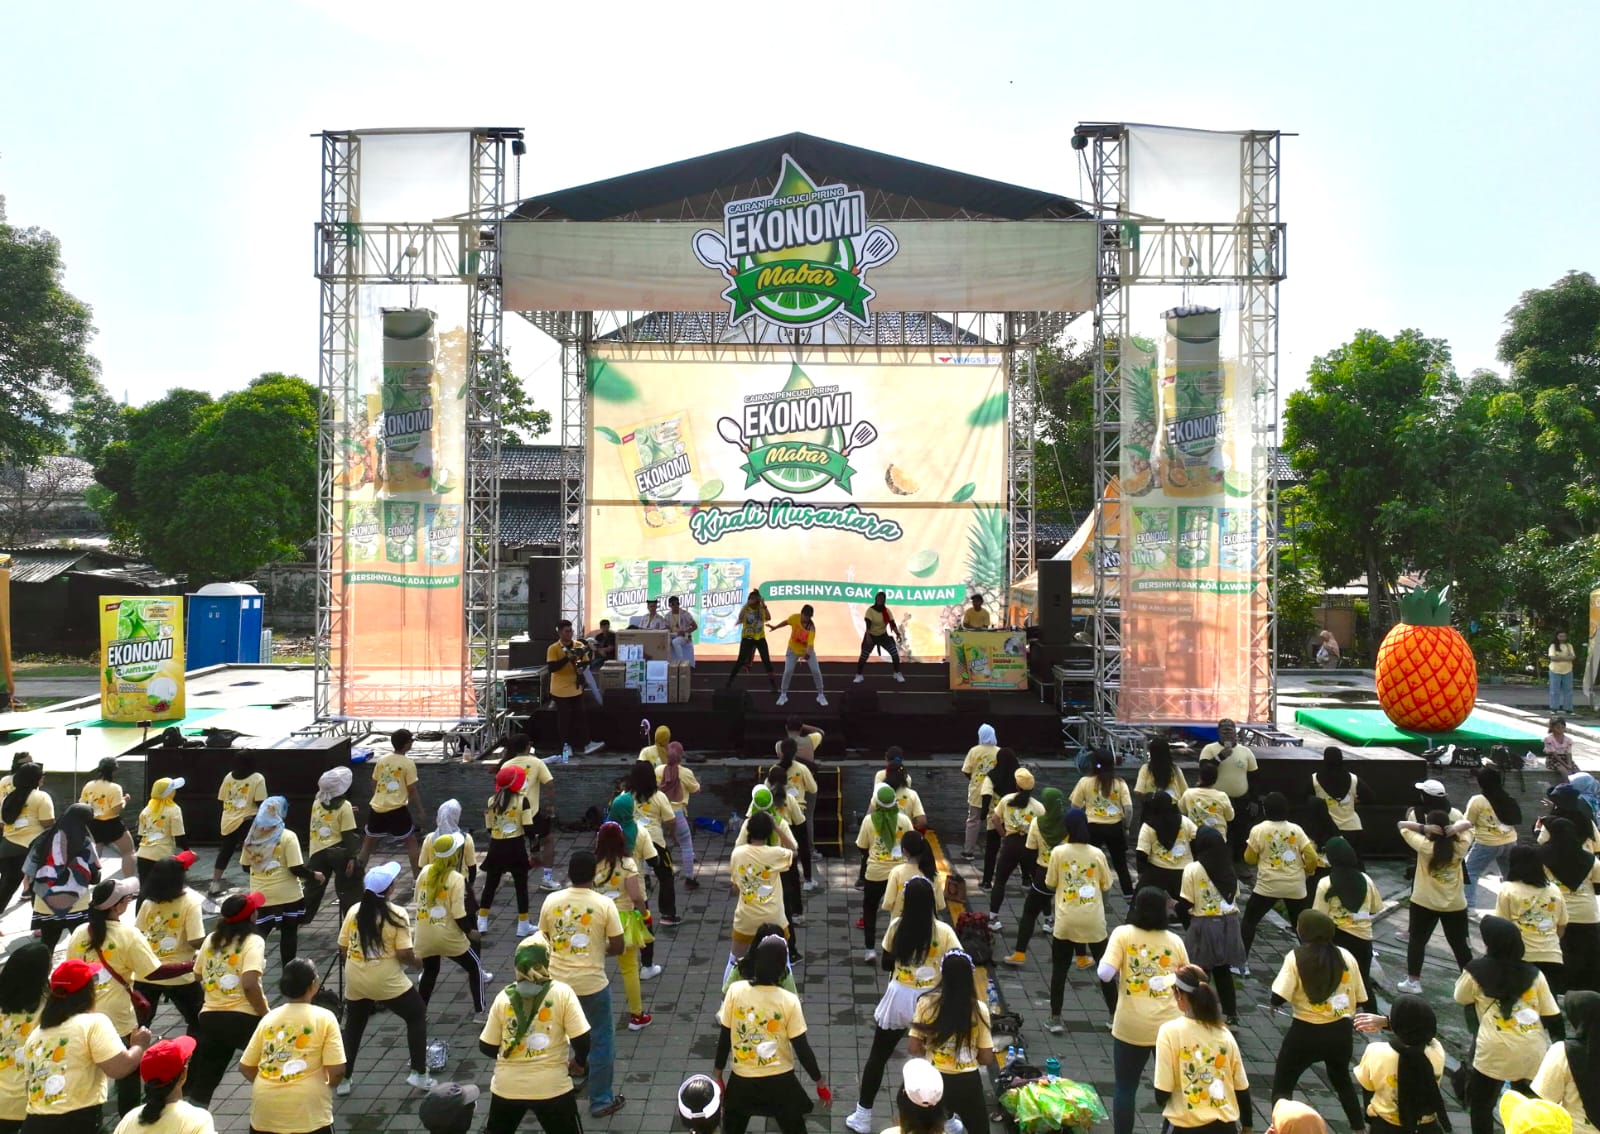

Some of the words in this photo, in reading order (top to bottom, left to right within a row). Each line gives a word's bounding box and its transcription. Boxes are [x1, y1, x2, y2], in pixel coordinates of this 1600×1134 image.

[728, 200, 766, 214] CAIRAN
[768, 193, 809, 206] PENCUCI
[810, 187, 845, 201] PIRING
[730, 197, 862, 256] EKONOMI
[757, 263, 837, 290] Mabar
[744, 392, 775, 403] CAIRAN
[776, 389, 810, 399] PENCUCI
[811, 385, 840, 394] PIRING
[380, 408, 433, 437] KONOMI
[744, 392, 852, 438] EKONOMI
[765, 445, 830, 465] Mabar
[635, 453, 691, 493] EKONOMI
[692, 502, 768, 542] Kuali
[769, 498, 902, 540] Nusantara
[408, 577, 425, 585] ADA
[769, 584, 842, 597] BERSIHNYA
[845, 586, 873, 598] GAK
[907, 588, 956, 601] LAWAN
[1199, 582, 1218, 590] ADA
[607, 588, 649, 608] EKONOMI
[656, 593, 697, 612] EKOOMI
[701, 589, 744, 609] EKONOMI
[107, 638, 173, 667] EKONOMI
